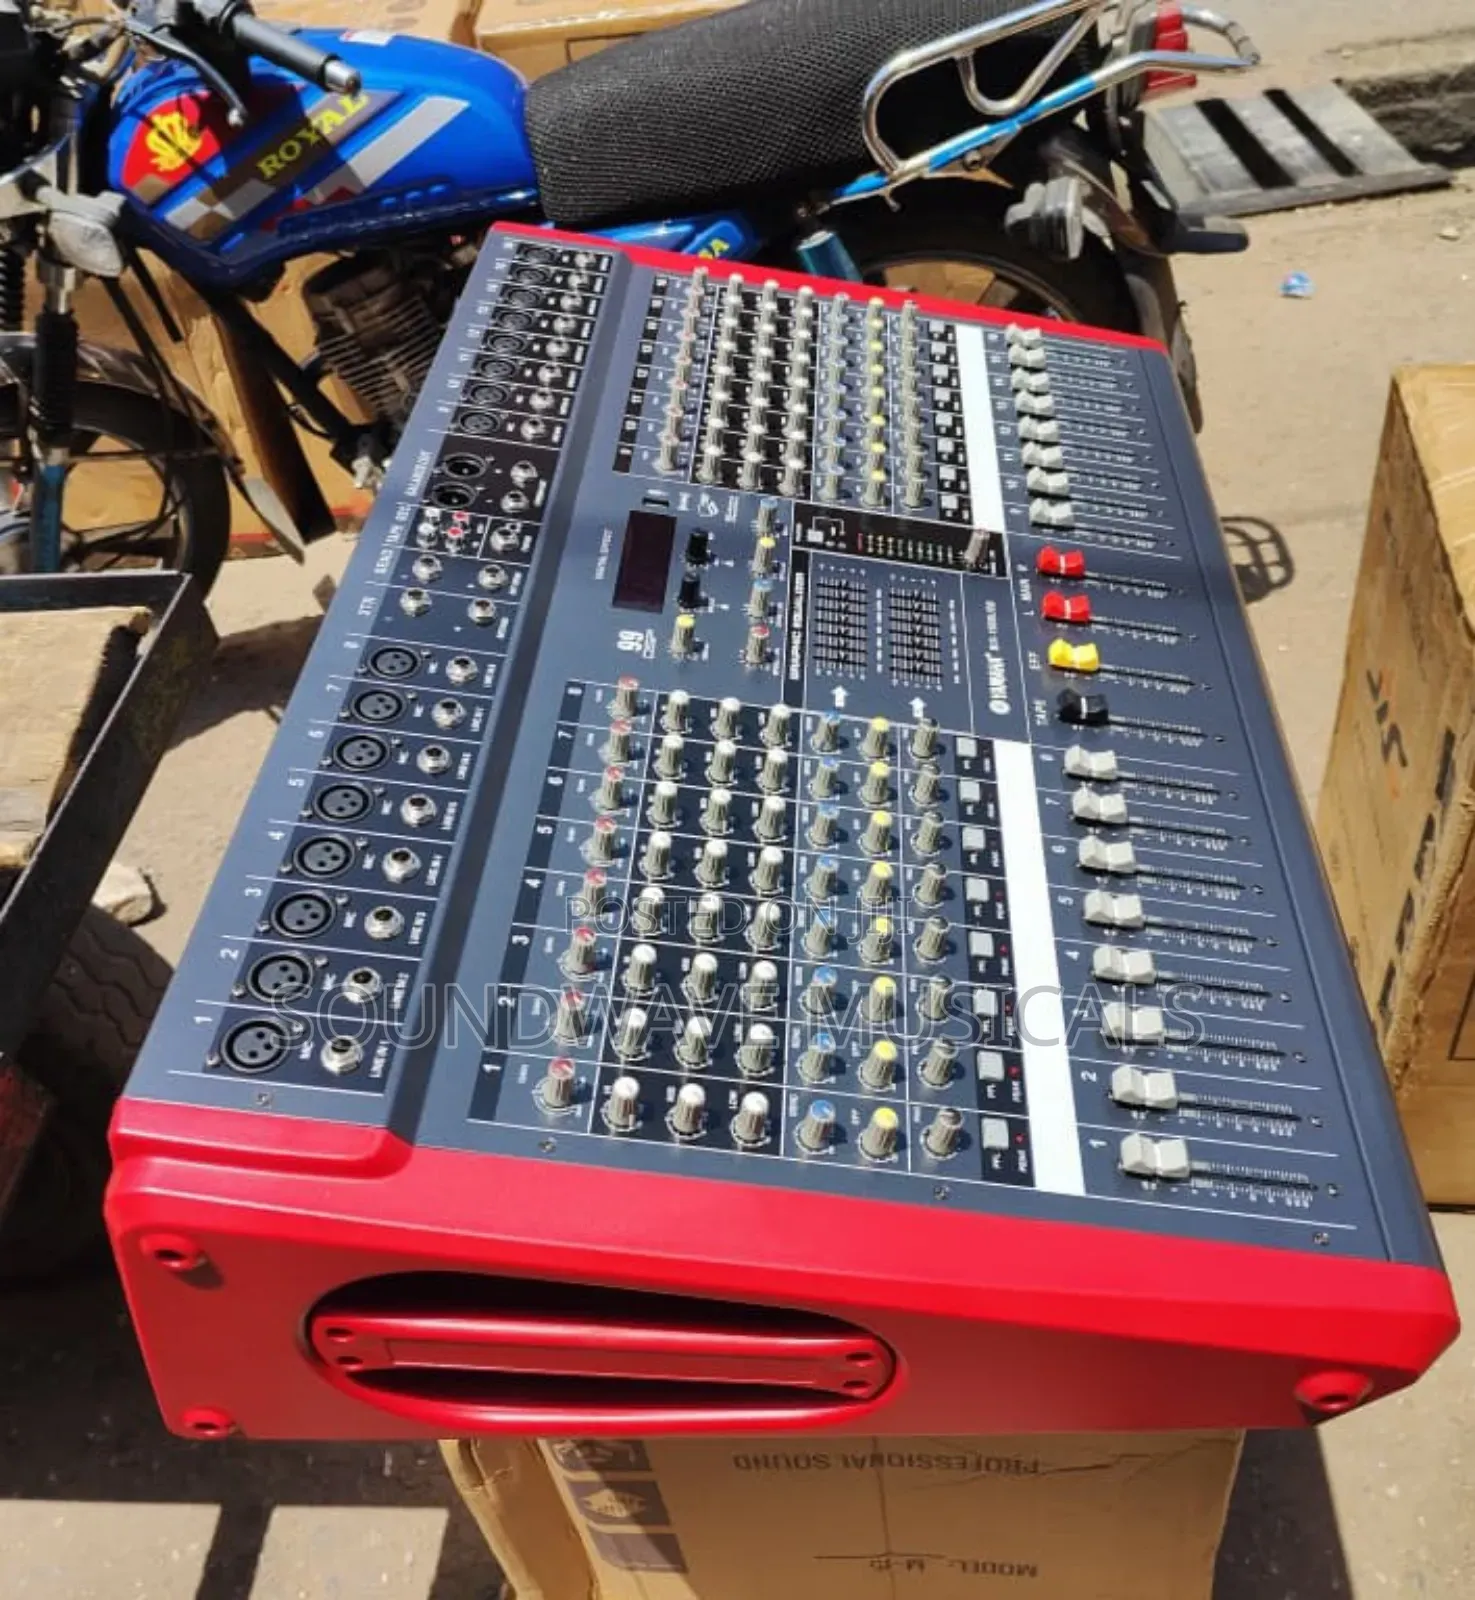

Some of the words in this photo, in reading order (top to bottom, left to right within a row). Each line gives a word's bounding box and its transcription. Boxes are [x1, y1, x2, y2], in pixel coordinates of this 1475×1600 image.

[257, 94, 369, 179] ROYAL
[1019, 578, 1033, 602] MAIN
[1028, 651, 1041, 670] EFF
[325, 683, 342, 692] 7
[1033, 699, 1048, 726] TAPE
[558, 731, 572, 740] 7
[288, 777, 305, 788] 5
[1044, 798, 1059, 806] 7
[537, 825, 553, 835] 5
[268, 831, 285, 841] 4
[524, 879, 541, 888] 4
[245, 887, 263, 897] 3
[1057, 896, 1073, 905] 5
[512, 934, 529, 946] 3
[220, 948, 239, 960] 2
[1064, 951, 1080, 961] 4
[498, 995, 516, 1007] 2
[194, 1015, 212, 1024] 1
[483, 1064, 501, 1074] 1
[1081, 1070, 1097, 1082] 2
[1088, 1138, 1107, 1148] 1
[731, 1452, 832, 1471] SOUND
[841, 1452, 1040, 1474] PROFESSIONAL
